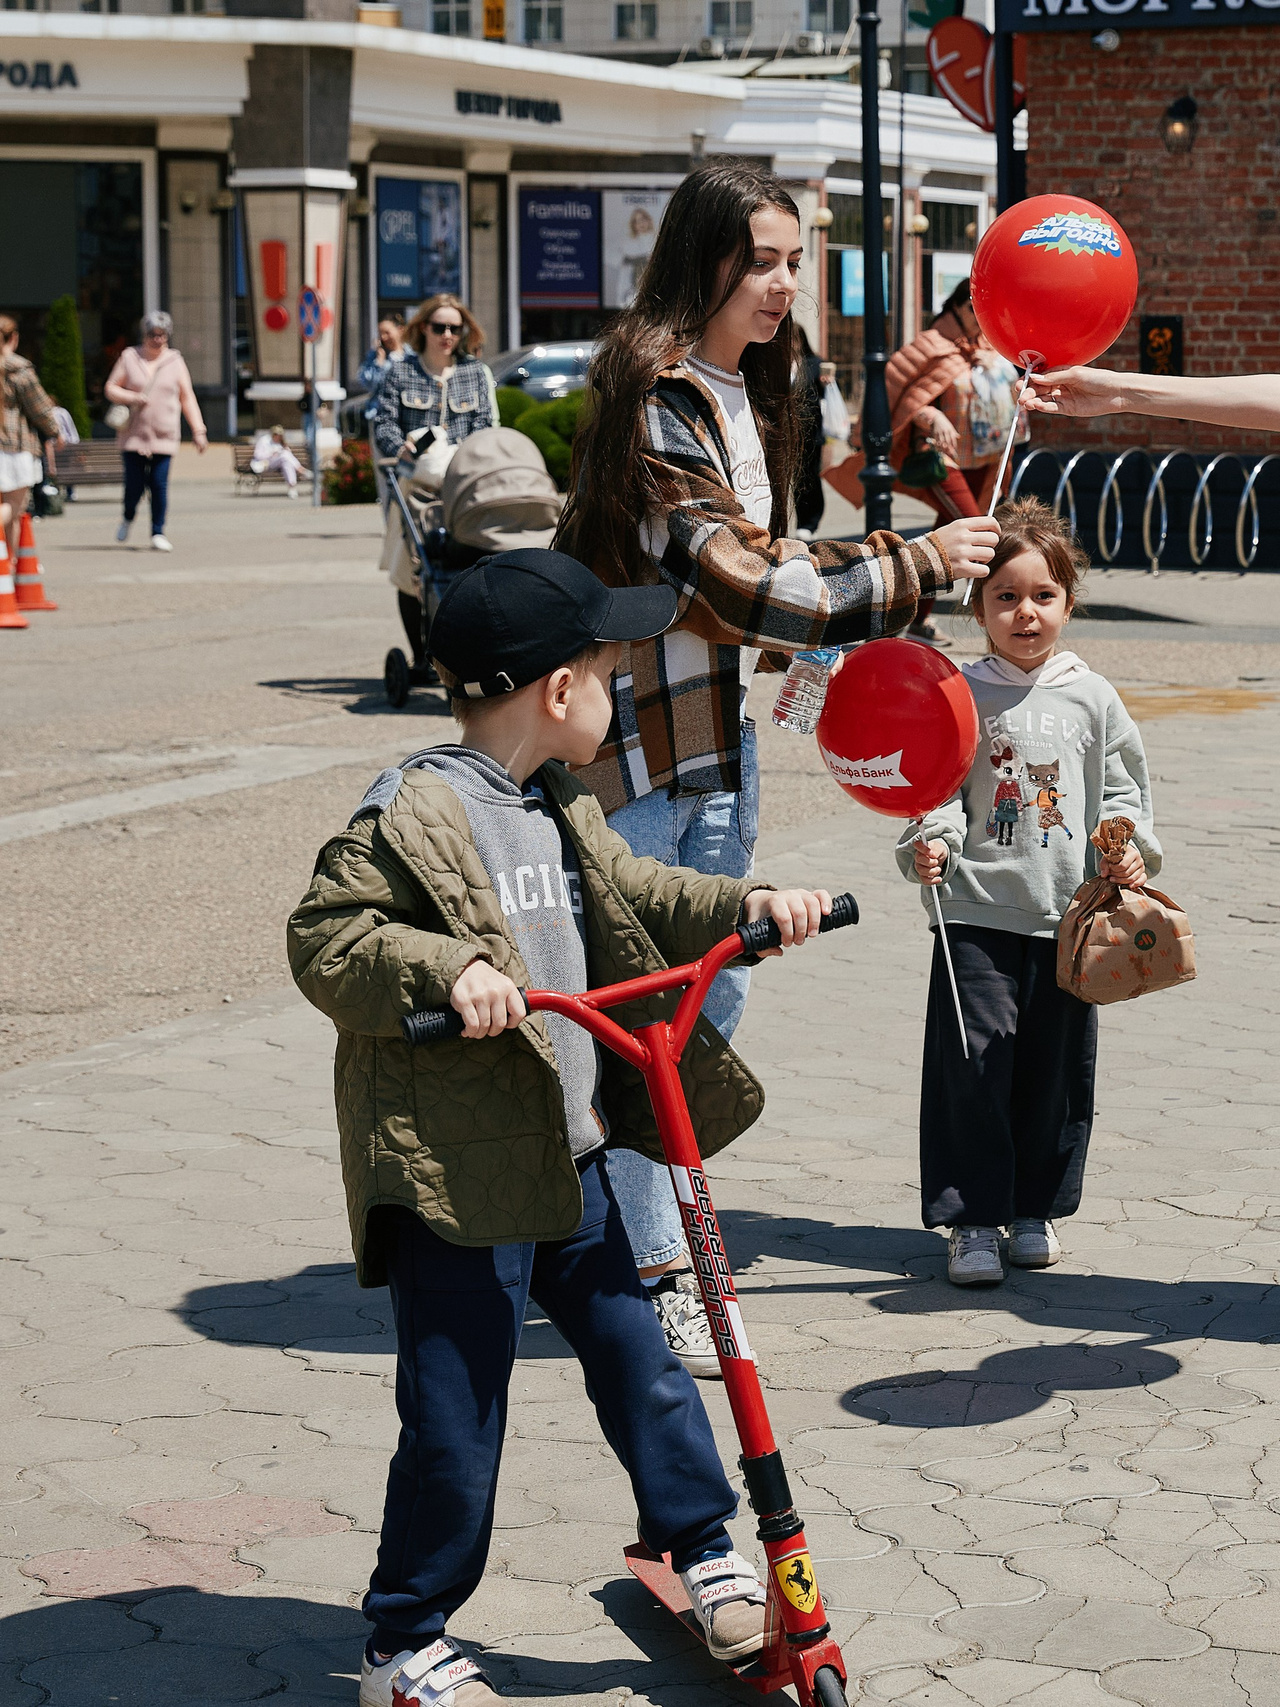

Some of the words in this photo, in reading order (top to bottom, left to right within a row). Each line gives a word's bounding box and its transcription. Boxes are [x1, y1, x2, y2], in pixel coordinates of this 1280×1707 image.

[0, 62, 79, 89] ОДА
[1018, 226, 1121, 253] ВЫГОДНО
[1039, 216, 1113, 240] АЛЬФА
[980, 711, 1097, 755] ELIEVE
[829, 761, 861, 778] Альфа
[861, 767, 894, 778] Банк
[689, 1168, 735, 1296] FERRARI
[698, 1561, 735, 1576] MICKEY
[700, 1583, 739, 1601] MOUSE
